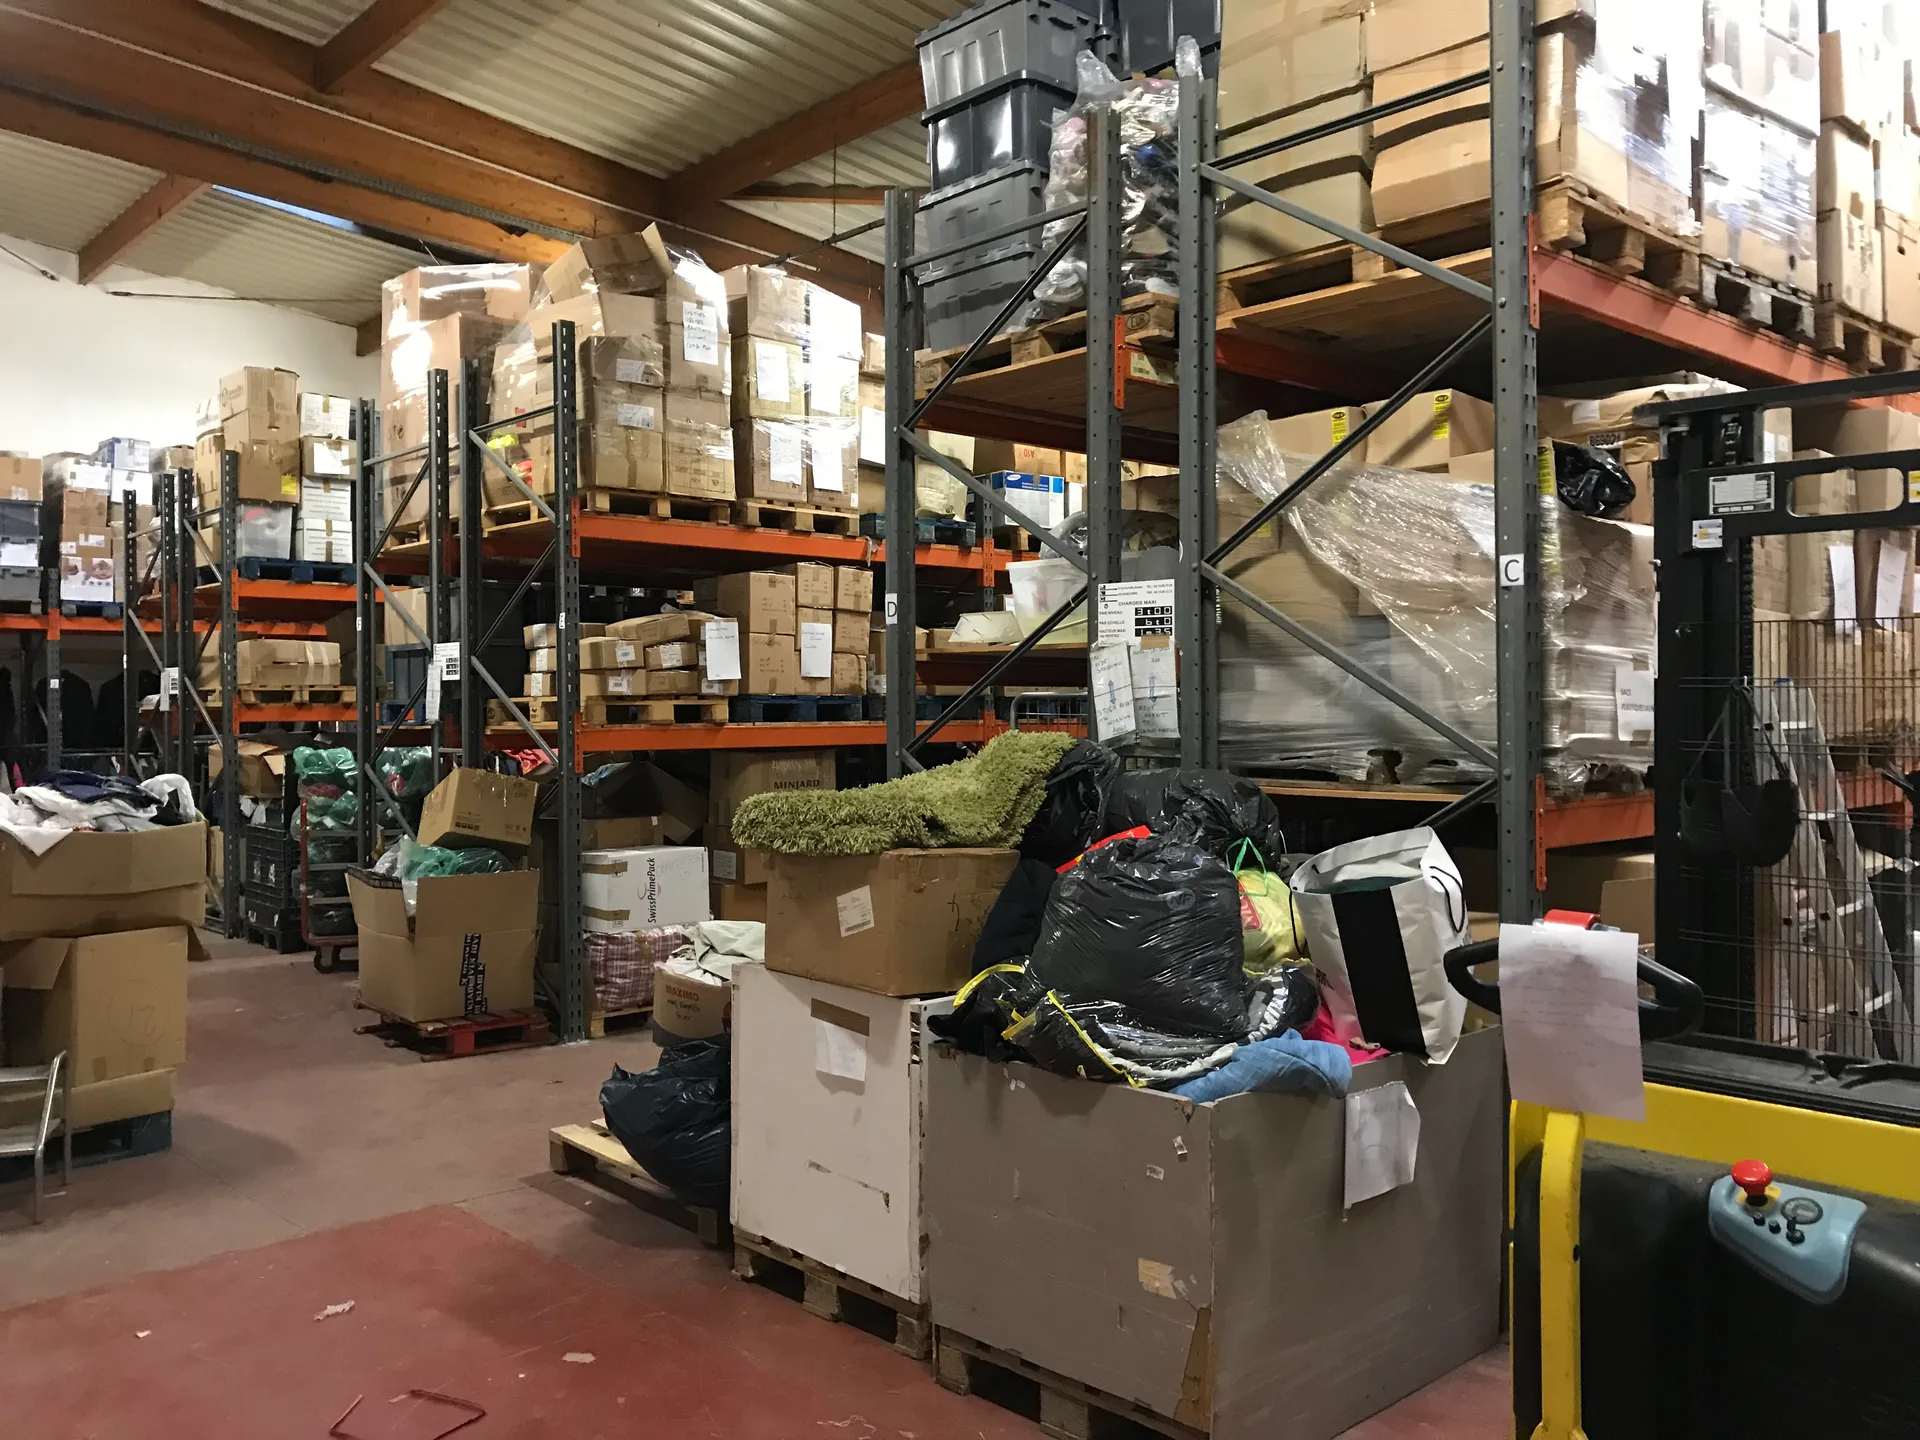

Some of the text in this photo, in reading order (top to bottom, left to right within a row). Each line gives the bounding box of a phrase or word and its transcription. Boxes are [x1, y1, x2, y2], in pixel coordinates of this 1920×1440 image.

[1130, 313, 1146, 328] EUR
[1504, 559, 1520, 583] C
[887, 601, 898, 618] D
[773, 779, 820, 790] MINJARD
[646, 857, 657, 924] SwissPrimePack
[475, 974, 484, 1002] KIABI
[665, 983, 700, 1002] MAXIMO
